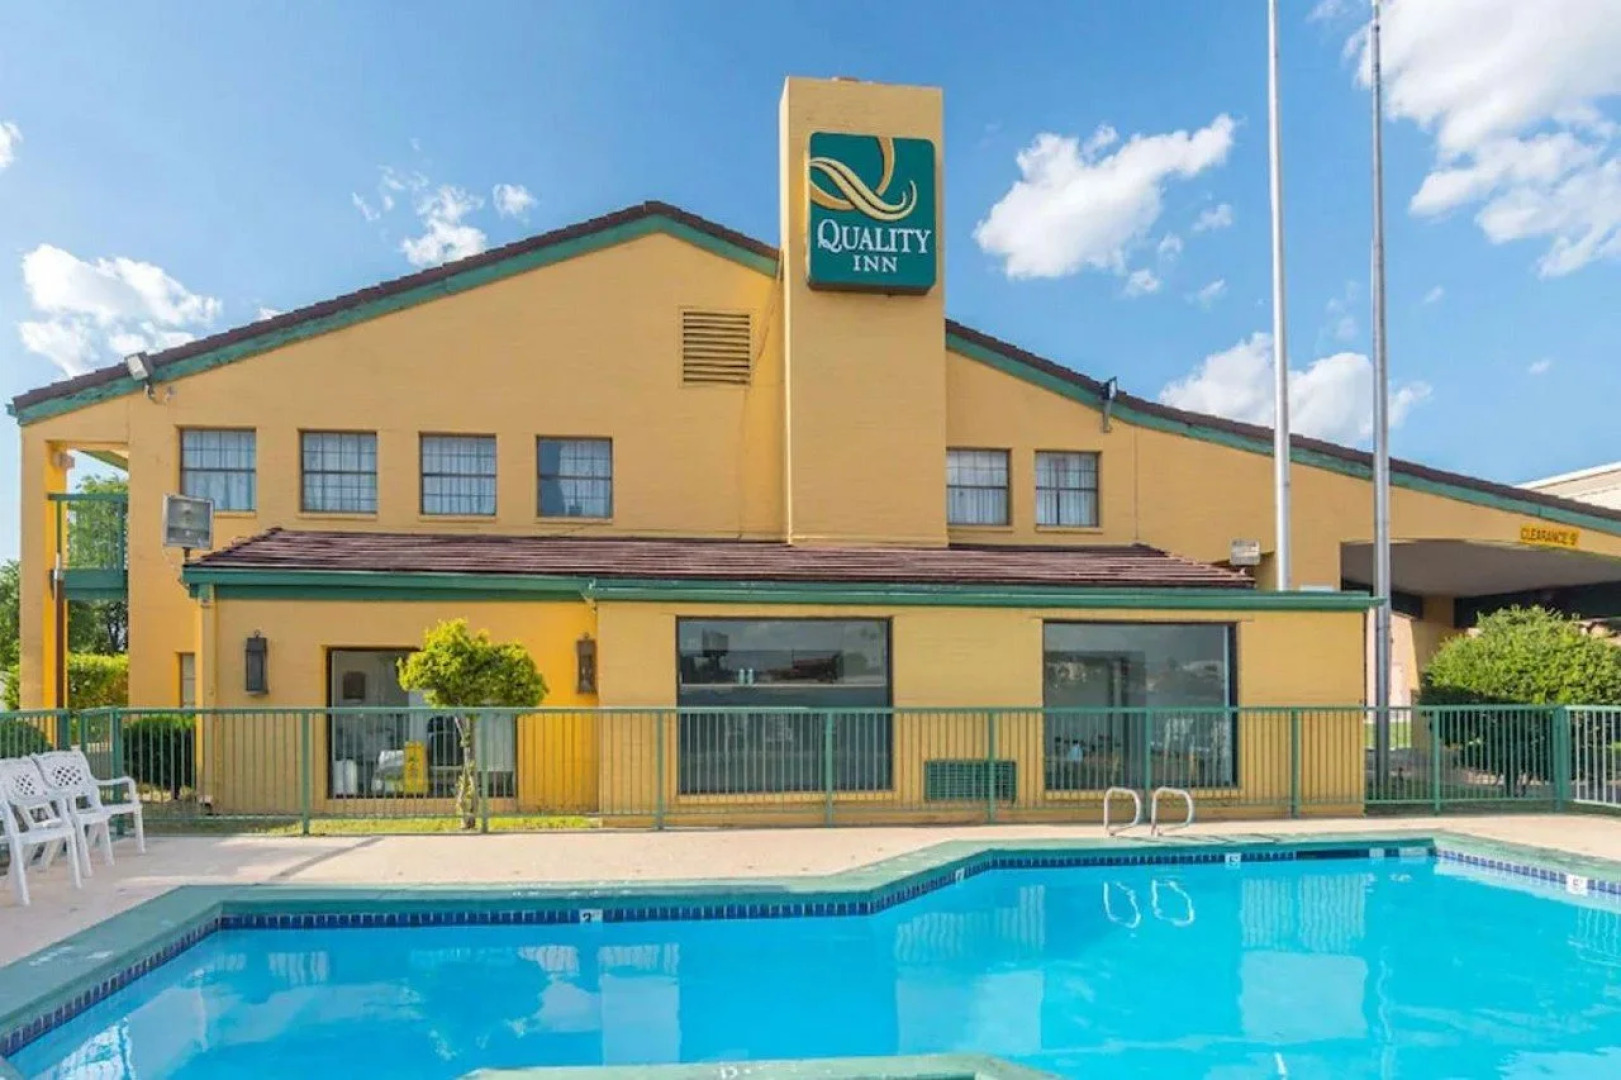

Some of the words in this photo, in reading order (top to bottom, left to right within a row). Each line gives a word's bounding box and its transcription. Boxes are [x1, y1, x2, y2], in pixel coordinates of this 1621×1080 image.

[817, 218, 932, 253] QUALITY
[853, 254, 898, 272] INN
[1520, 527, 1568, 544] CLEARANCE
